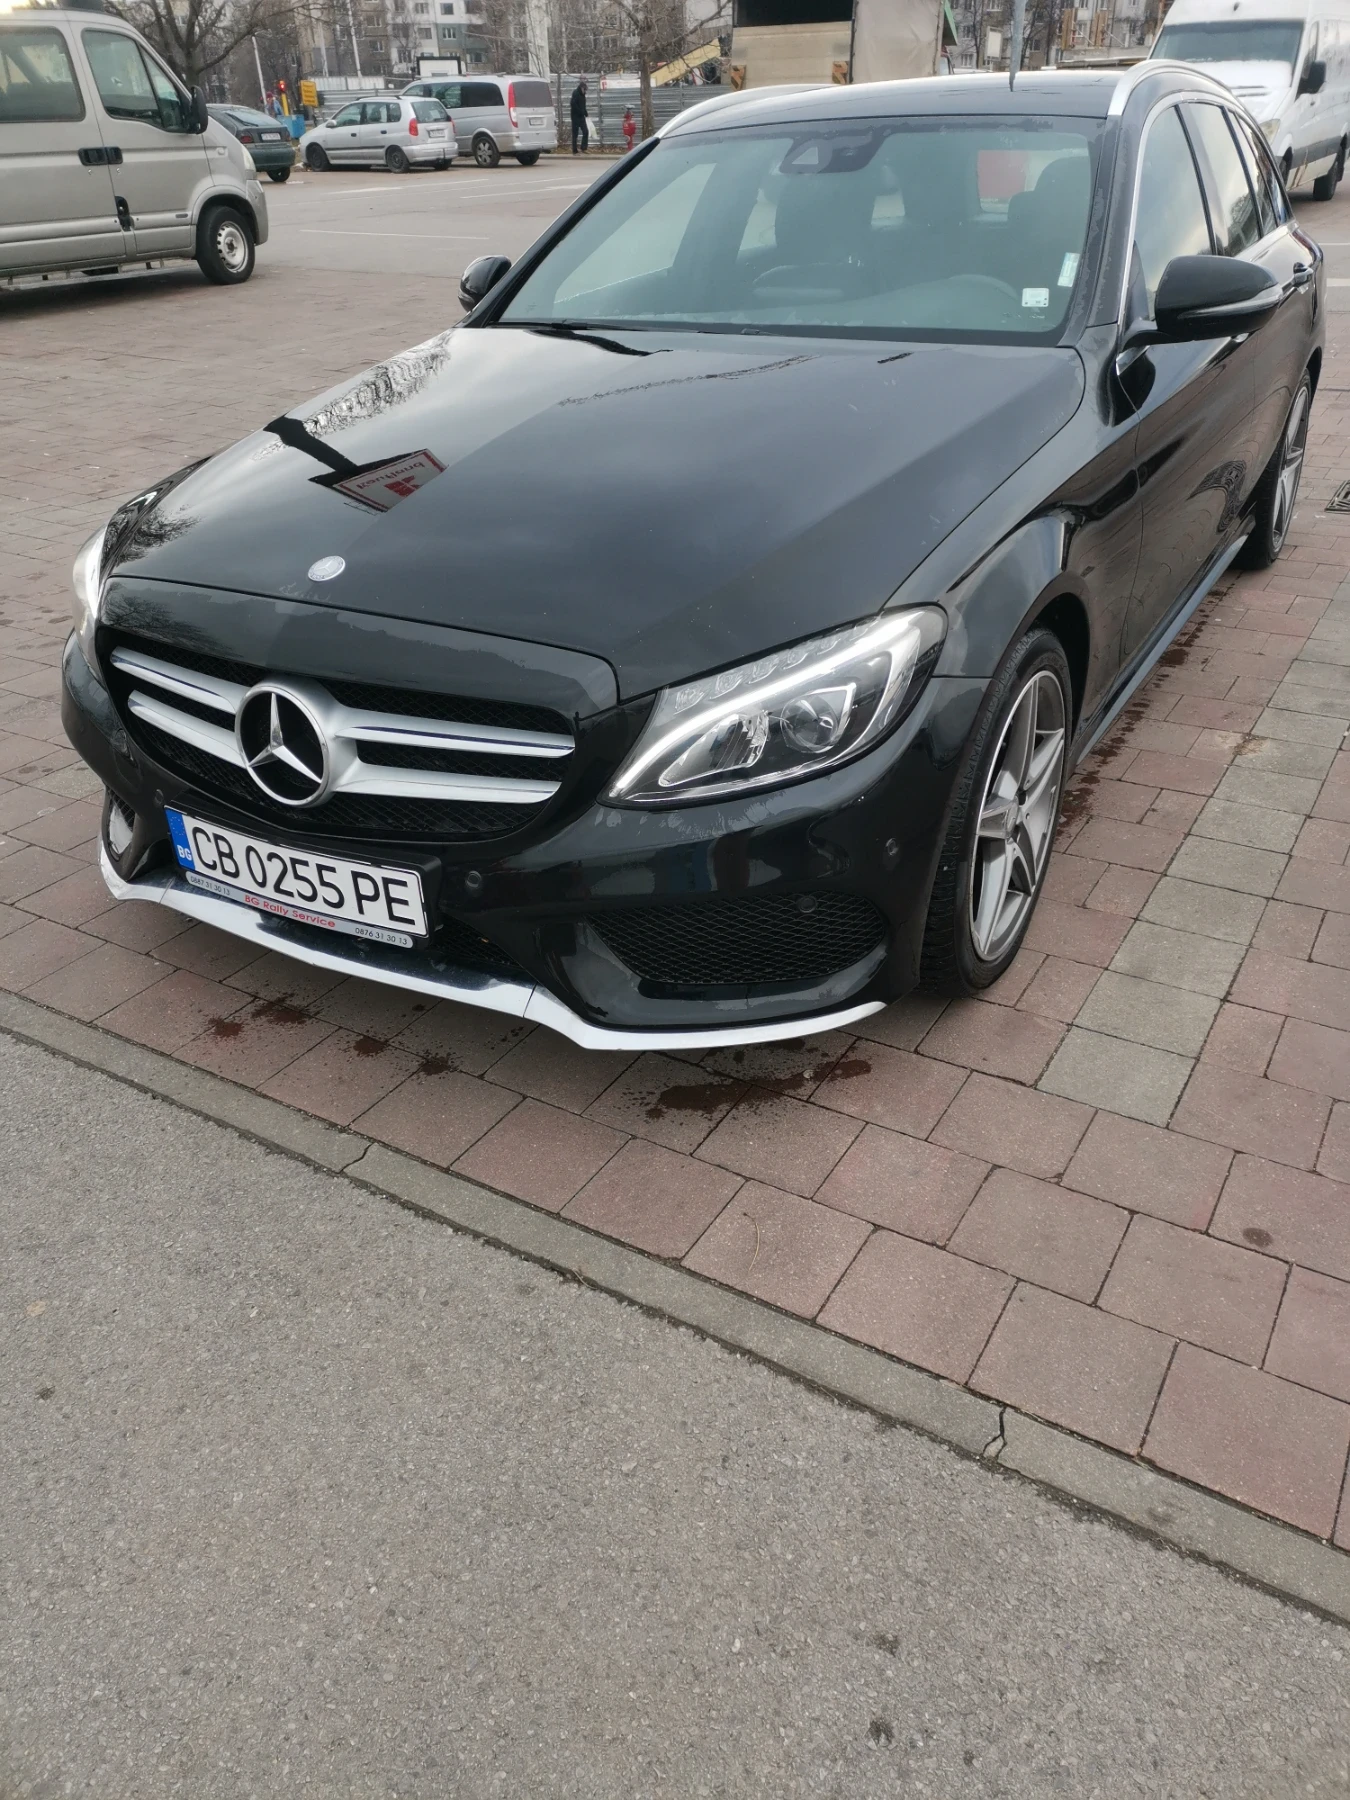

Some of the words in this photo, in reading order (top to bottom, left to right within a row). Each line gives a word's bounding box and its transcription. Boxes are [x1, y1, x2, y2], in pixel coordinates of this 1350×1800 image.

[177, 844, 192, 861] BG
[244, 894, 260, 906] BG
[263, 901, 289, 916] Rally
[292, 910, 336, 928] Service
[355, 927, 374, 938] 0876
[374, 931, 384, 940] 31
[386, 934, 396, 943] 30
[399, 937, 408, 946] 13
